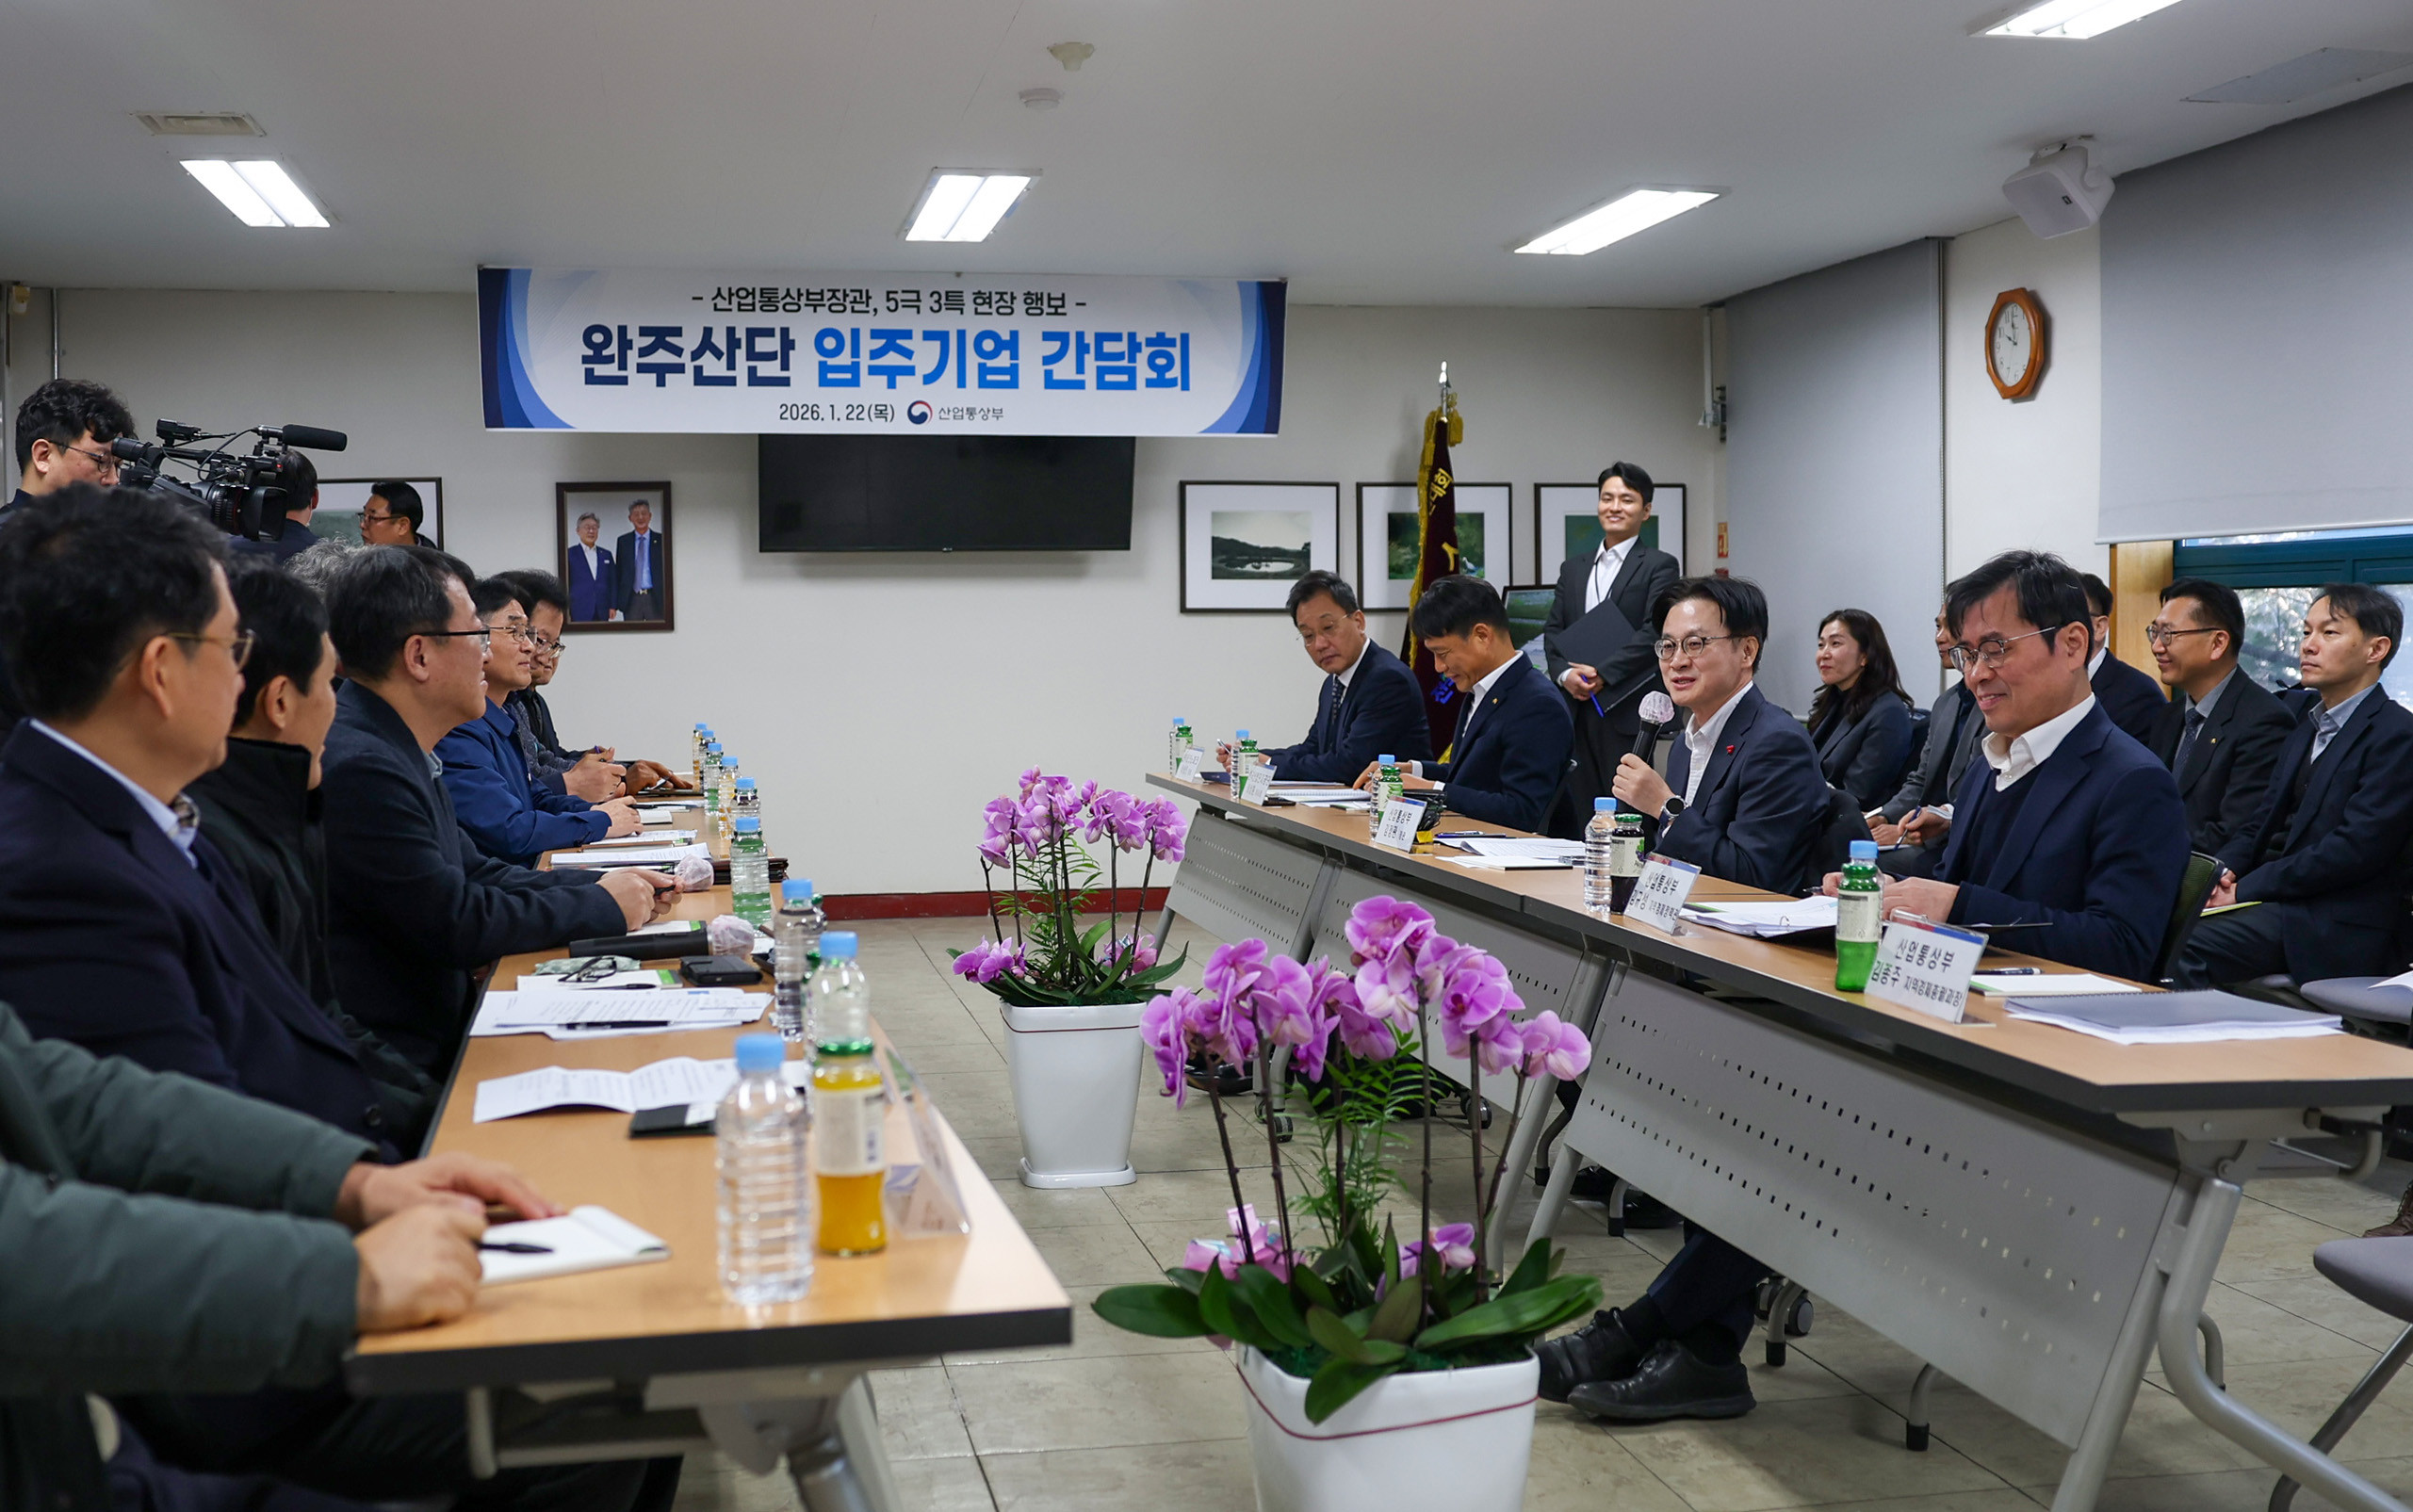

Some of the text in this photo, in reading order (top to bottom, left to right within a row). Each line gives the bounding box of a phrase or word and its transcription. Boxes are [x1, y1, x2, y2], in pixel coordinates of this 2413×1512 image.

[710, 286, 877, 317] 산업통상부장관,
[886, 289, 921, 316] 5극
[929, 289, 965, 316] 3특
[972, 289, 1018, 317] 현장
[1023, 290, 1068, 317] 행보
[580, 324, 1191, 392] 완주산단 입주기업 간담회
[938, 406, 1004, 421] 산업통상부
[1895, 938, 1955, 972] 산업통상부
